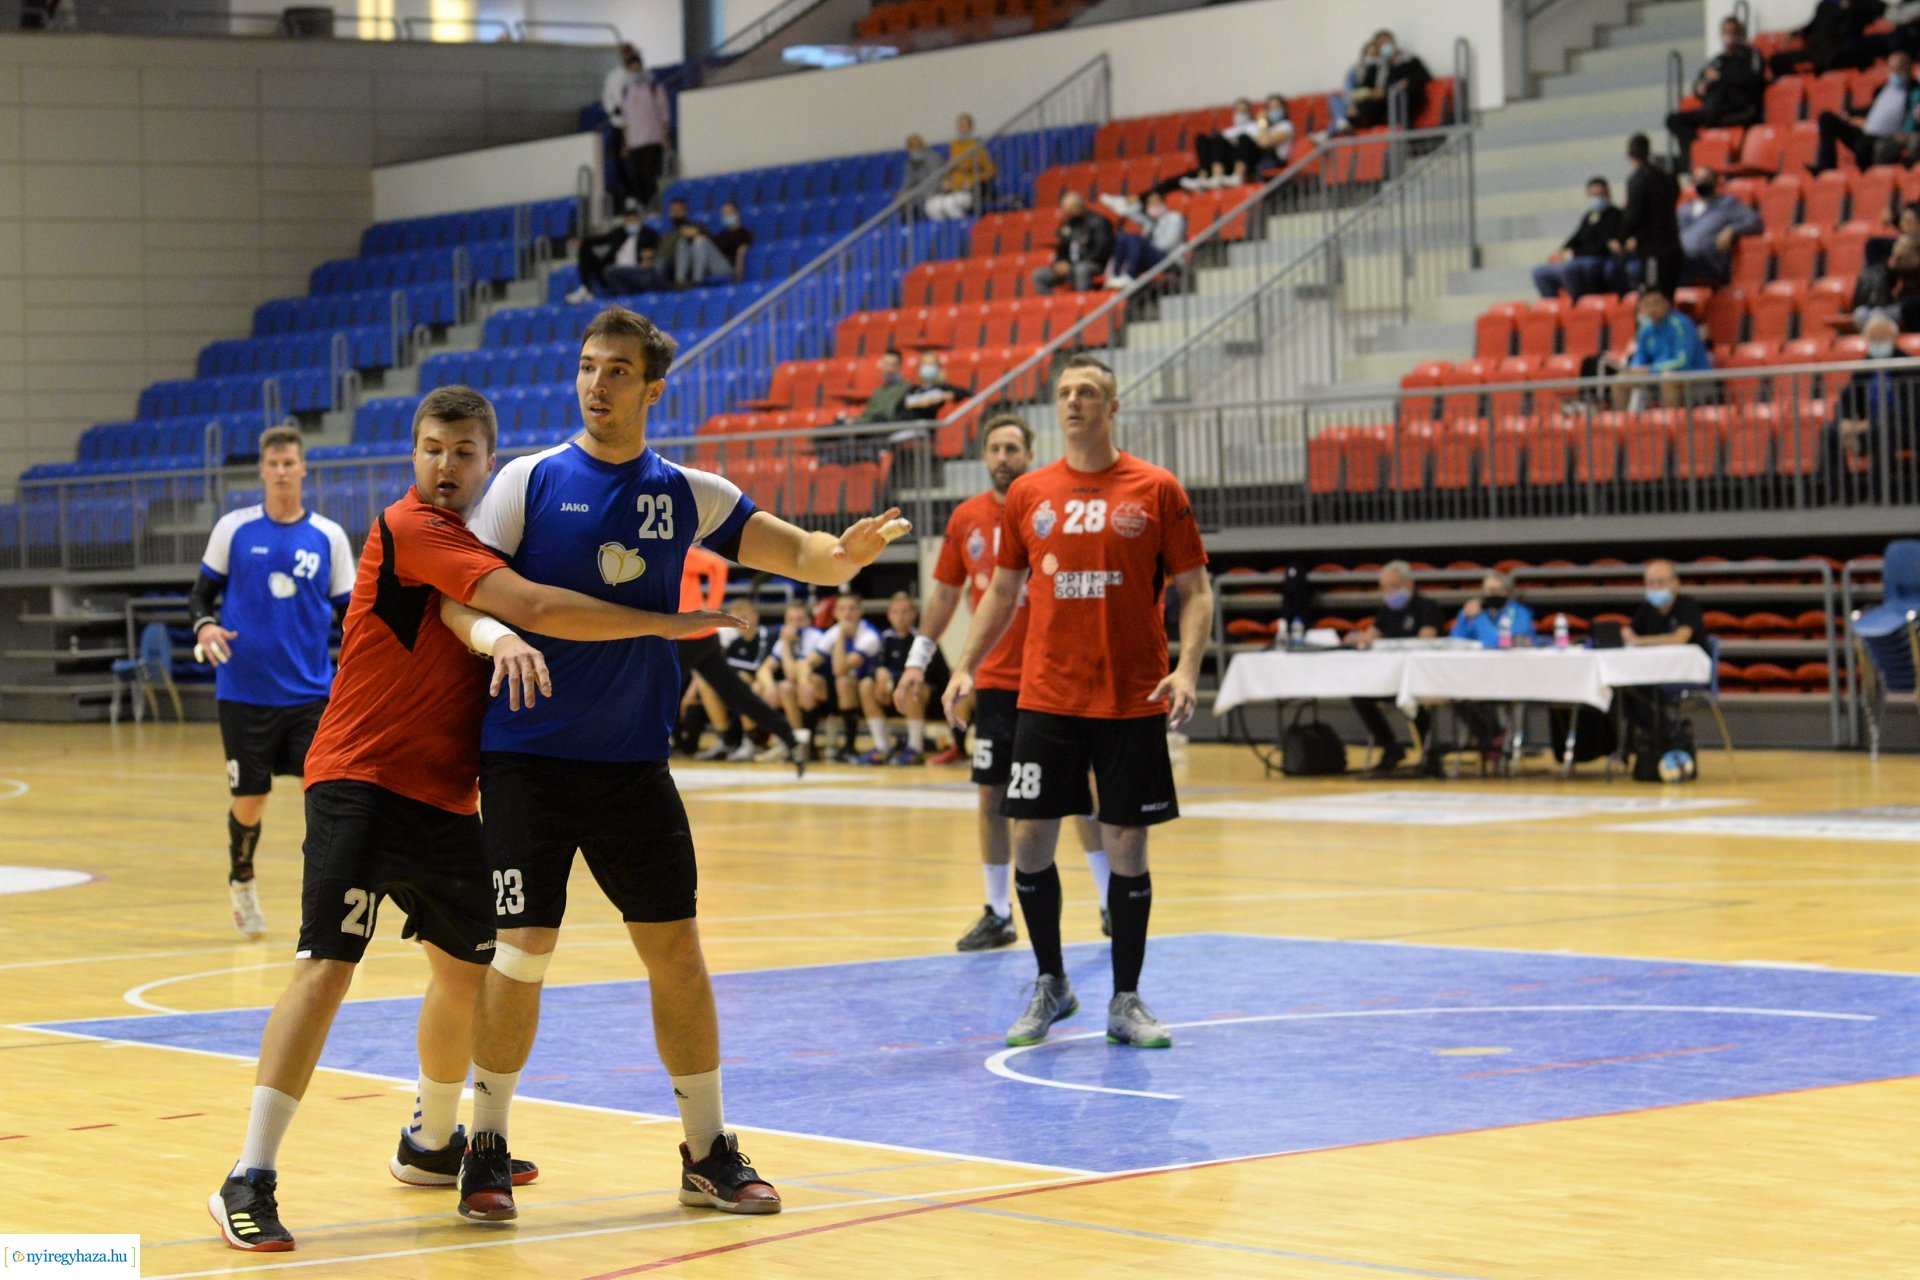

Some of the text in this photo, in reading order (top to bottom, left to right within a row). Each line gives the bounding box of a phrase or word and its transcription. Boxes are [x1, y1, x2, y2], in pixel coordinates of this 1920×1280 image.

[560, 503, 589, 512] JAKO
[636, 494, 674, 539] 23
[1063, 499, 1107, 534] 28
[293, 549, 320, 579] 29
[1055, 571, 1123, 585] OPTIMUM
[226, 759, 240, 788] 9
[1007, 762, 1042, 799] 28
[492, 868, 525, 916] 23
[340, 887, 377, 939] 21
